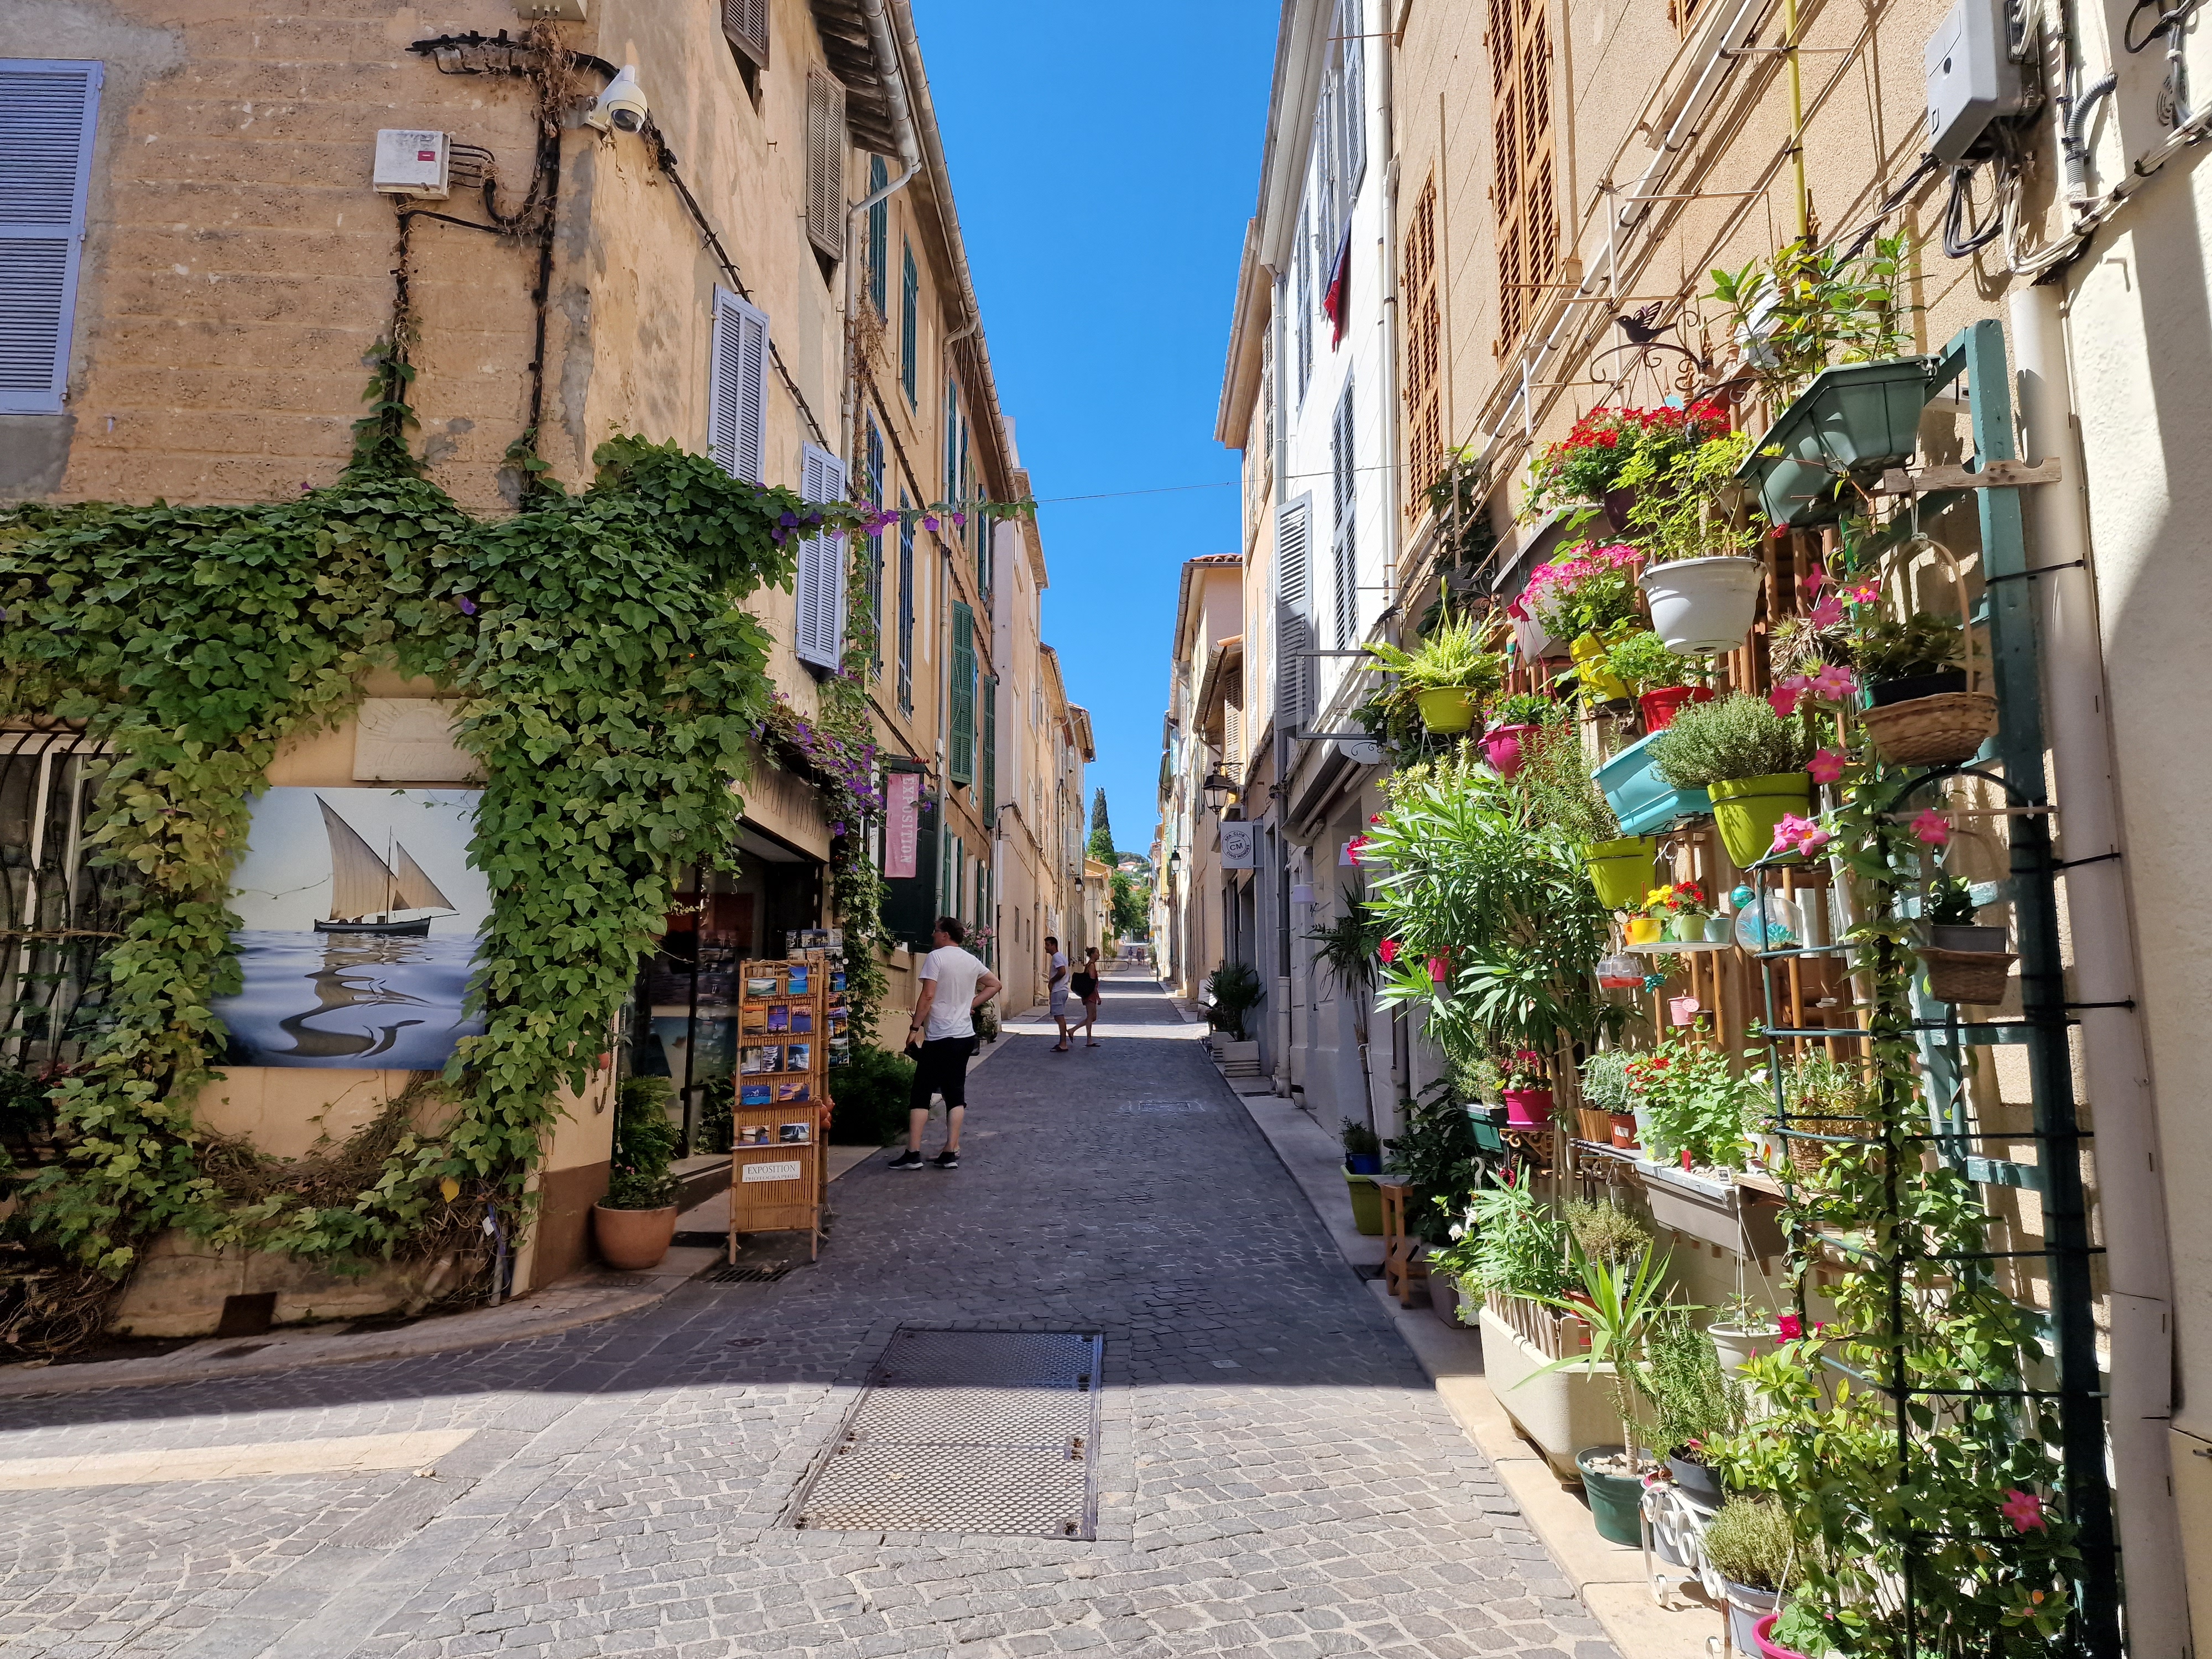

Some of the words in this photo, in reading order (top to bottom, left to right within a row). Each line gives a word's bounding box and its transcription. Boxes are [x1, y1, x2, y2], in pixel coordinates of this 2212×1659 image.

[900, 777, 916, 864] EXPOSITION
[1238, 845, 1250, 858] MONDES
[748, 1164, 796, 1175] EXPOSITION
